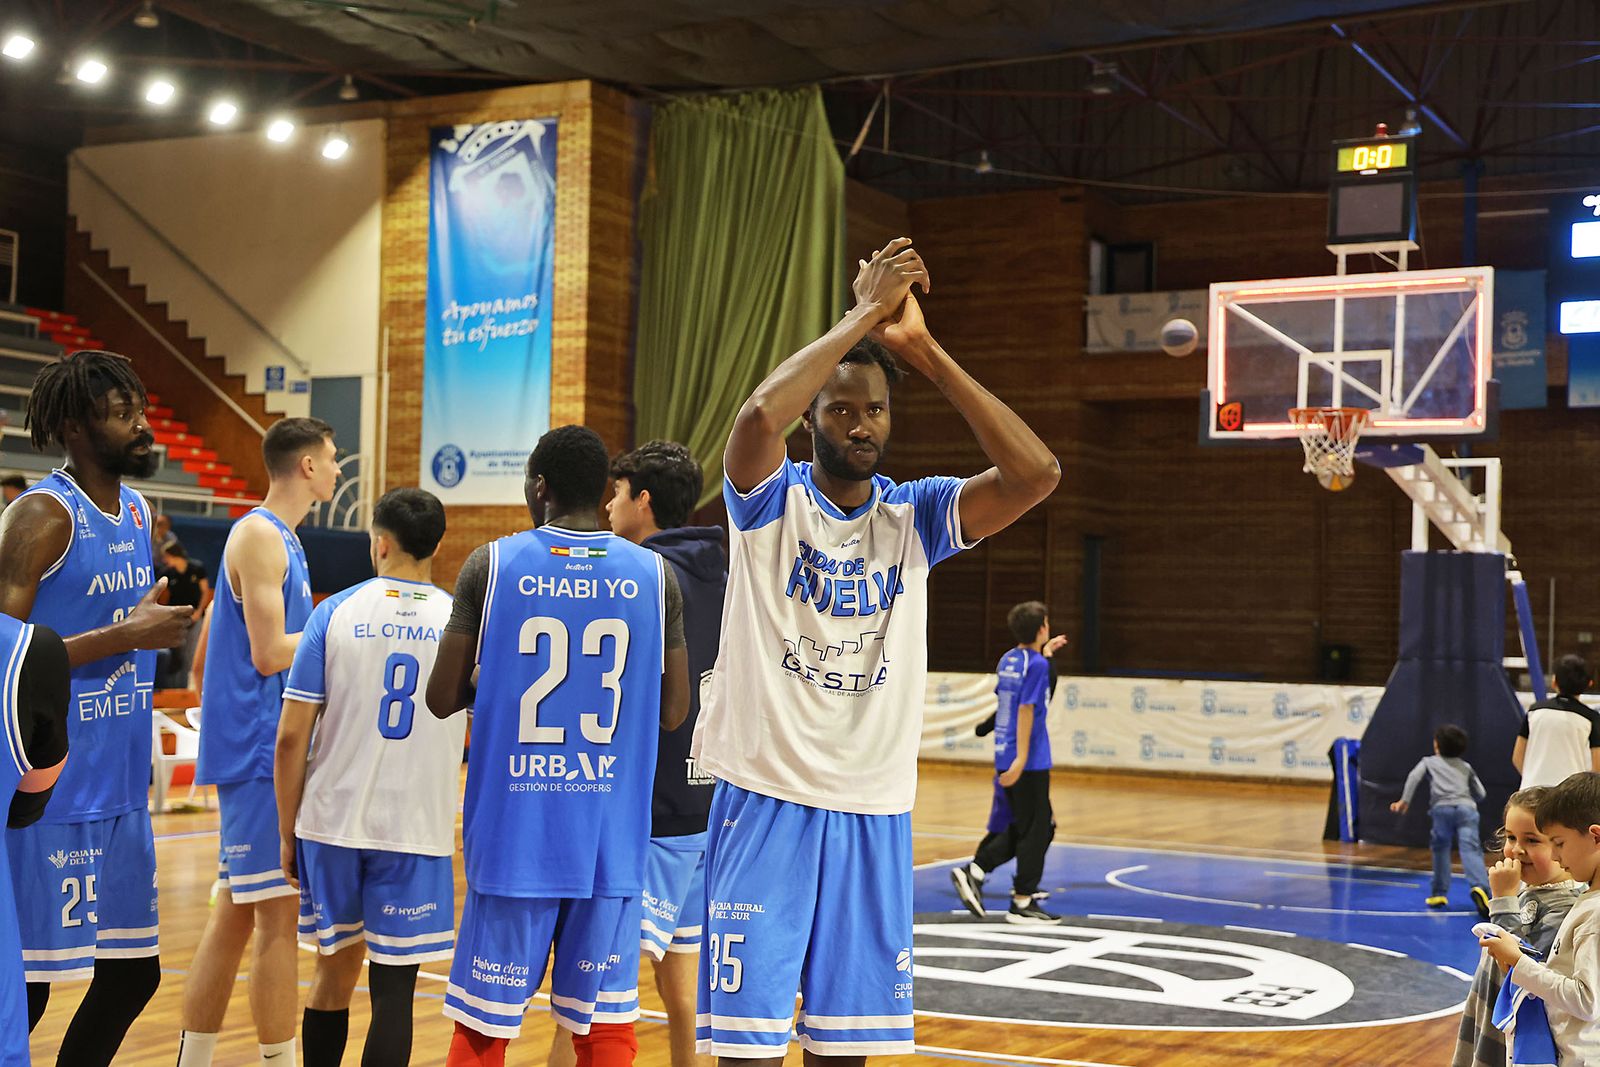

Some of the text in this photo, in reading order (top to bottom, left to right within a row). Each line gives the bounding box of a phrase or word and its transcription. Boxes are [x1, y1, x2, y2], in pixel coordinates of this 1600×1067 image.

[467, 317, 540, 352] esfuerzo
[842, 557, 865, 577] DE
[518, 575, 639, 599] CHABI YO
[354, 623, 376, 639] EL
[518, 616, 631, 745] 23
[377, 652, 420, 741] 8
[509, 782, 548, 792] GESTIÓN
[550, 783, 562, 792] DE
[61, 873, 98, 928] 25
[733, 902, 766, 913] RURAL
[715, 910, 751, 921] DEL SUR
[502, 961, 530, 976] eleva
[709, 932, 747, 993] 35
[894, 991, 905, 999] DE
